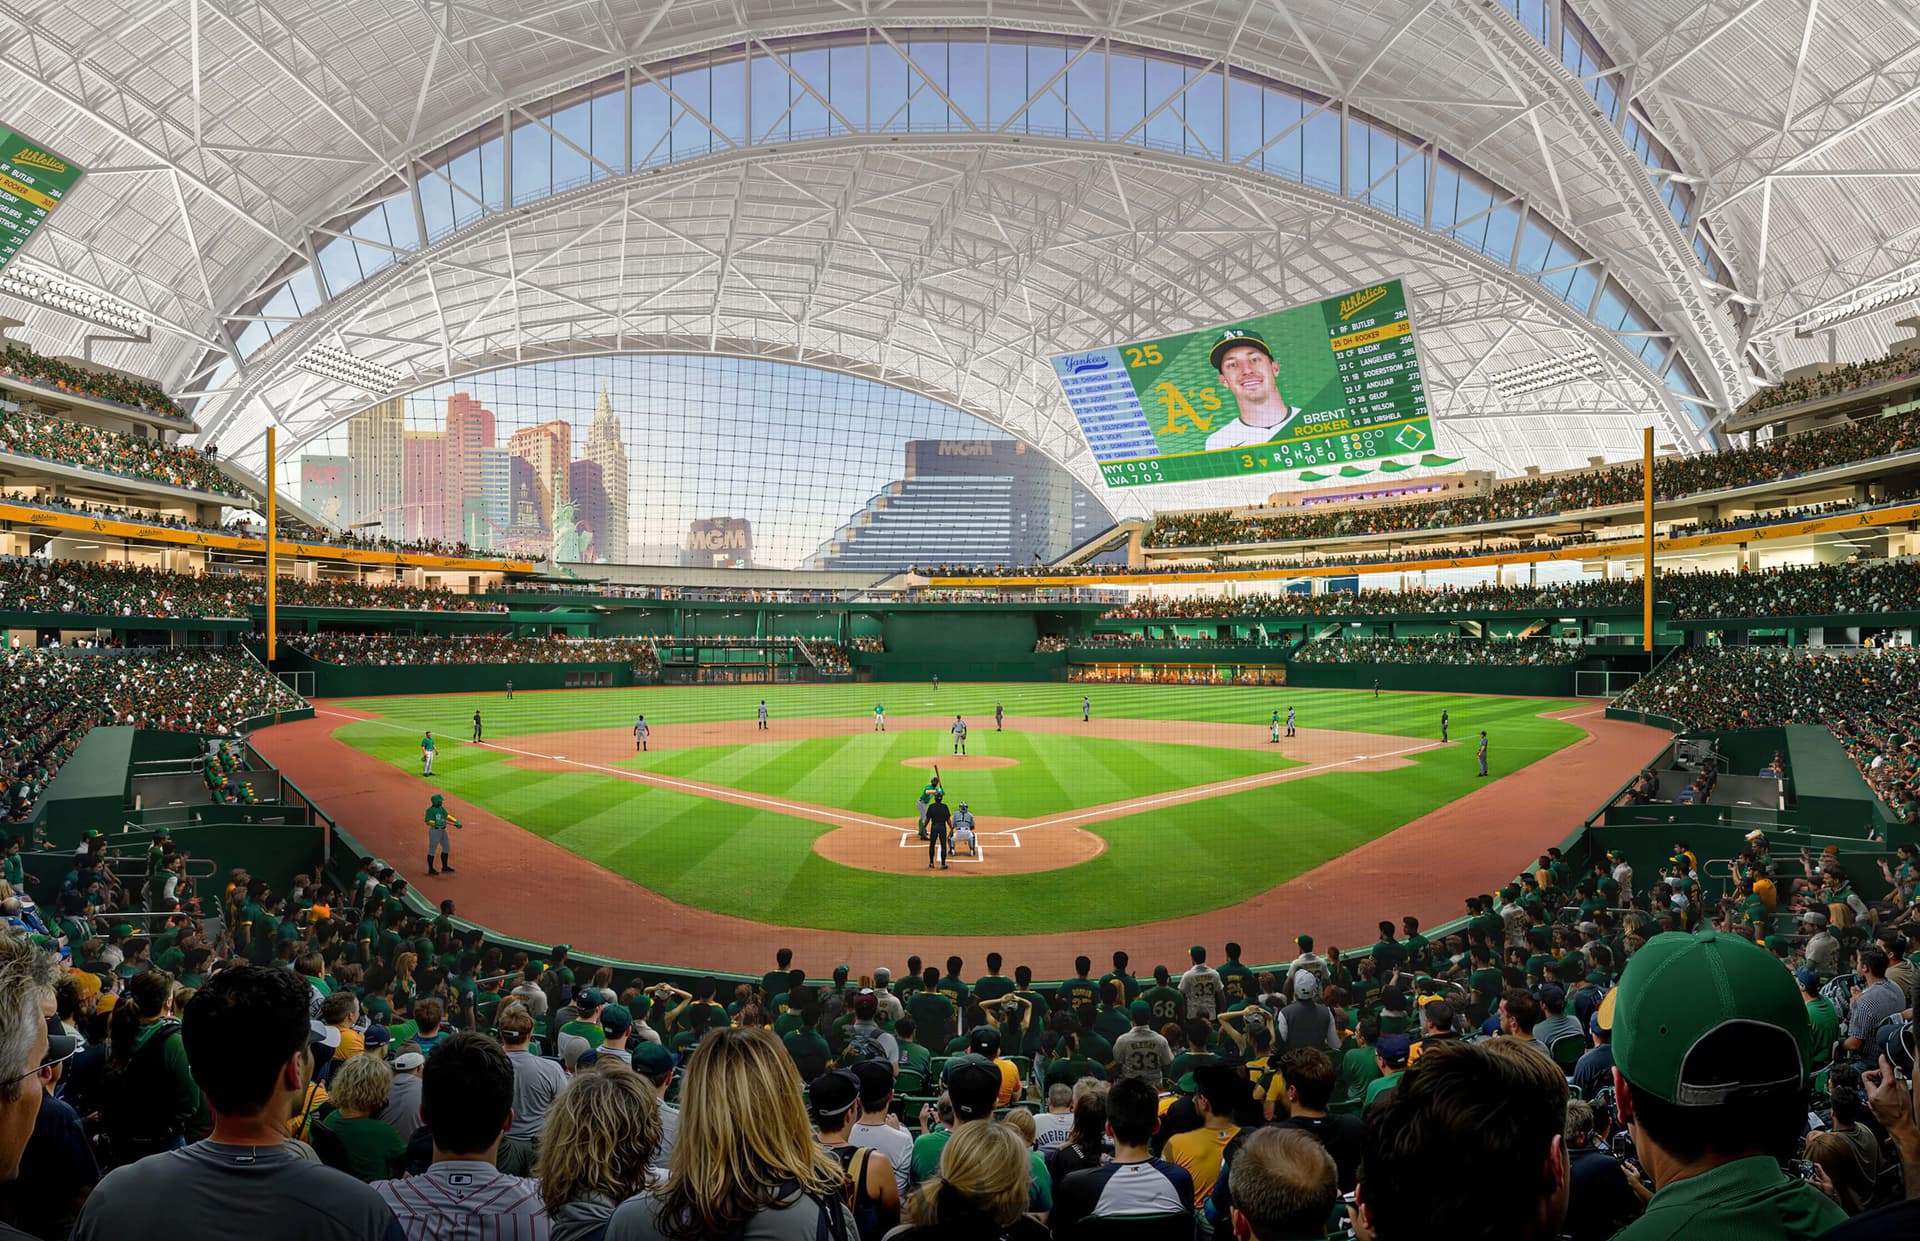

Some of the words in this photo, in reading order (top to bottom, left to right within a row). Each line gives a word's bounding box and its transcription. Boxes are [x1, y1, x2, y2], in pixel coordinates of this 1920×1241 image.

[11, 148, 66, 172] Athletics
[11, 169, 35, 185] BUTLER
[4, 179, 29, 195] ROOKER
[0, 190, 19, 204] LEDAY
[1339, 286, 1387, 318] Athletics
[1351, 319, 1375, 331] BUTLER
[1343, 338, 1353, 346] DH
[1355, 330, 1380, 343] ROOKER
[1125, 344, 1164, 369] 25
[1346, 349, 1354, 357] CF
[1357, 343, 1381, 355] BLEDAY
[1062, 353, 1108, 374] Yankees
[1360, 352, 1397, 366] LANGELIERS
[1363, 363, 1404, 378] SODERSTROM
[1366, 378, 1395, 390] ANDUJAR
[1368, 391, 1388, 401] GELOF
[1155, 382, 1222, 437] A's
[1360, 406, 1368, 414] SS
[1371, 401, 1395, 412] WILSON
[1303, 408, 1346, 425] BRENT
[1374, 412, 1402, 422] URSHELA
[1293, 419, 1350, 436] ROOKER
[938, 440, 993, 456] MGM
[1281, 445, 1289, 454] 0
[1302, 442, 1311, 451] 3
[1325, 439, 1331, 448] 1
[1241, 454, 1254, 468] 3
[1273, 453, 1281, 463] R
[1294, 450, 1303, 459] H
[1316, 447, 1324, 456] E
[1284, 458, 1293, 467] 9
[1304, 455, 1316, 464] 10
[1328, 452, 1336, 461] 0
[1103, 464, 1123, 475] NYY
[1127, 463, 1135, 472] 0
[1139, 462, 1147, 471] 0
[1151, 461, 1159, 470] 0
[1107, 475, 1129, 486] LVA
[1131, 474, 1139, 483] 7
[1144, 473, 1152, 482] 0
[1157, 472, 1165, 481] 2
[688, 530, 746, 550] MGM
[1194, 982, 1214, 997] 33
[1152, 1000, 1176, 1019] 68
[1131, 1051, 1159, 1071] 33
